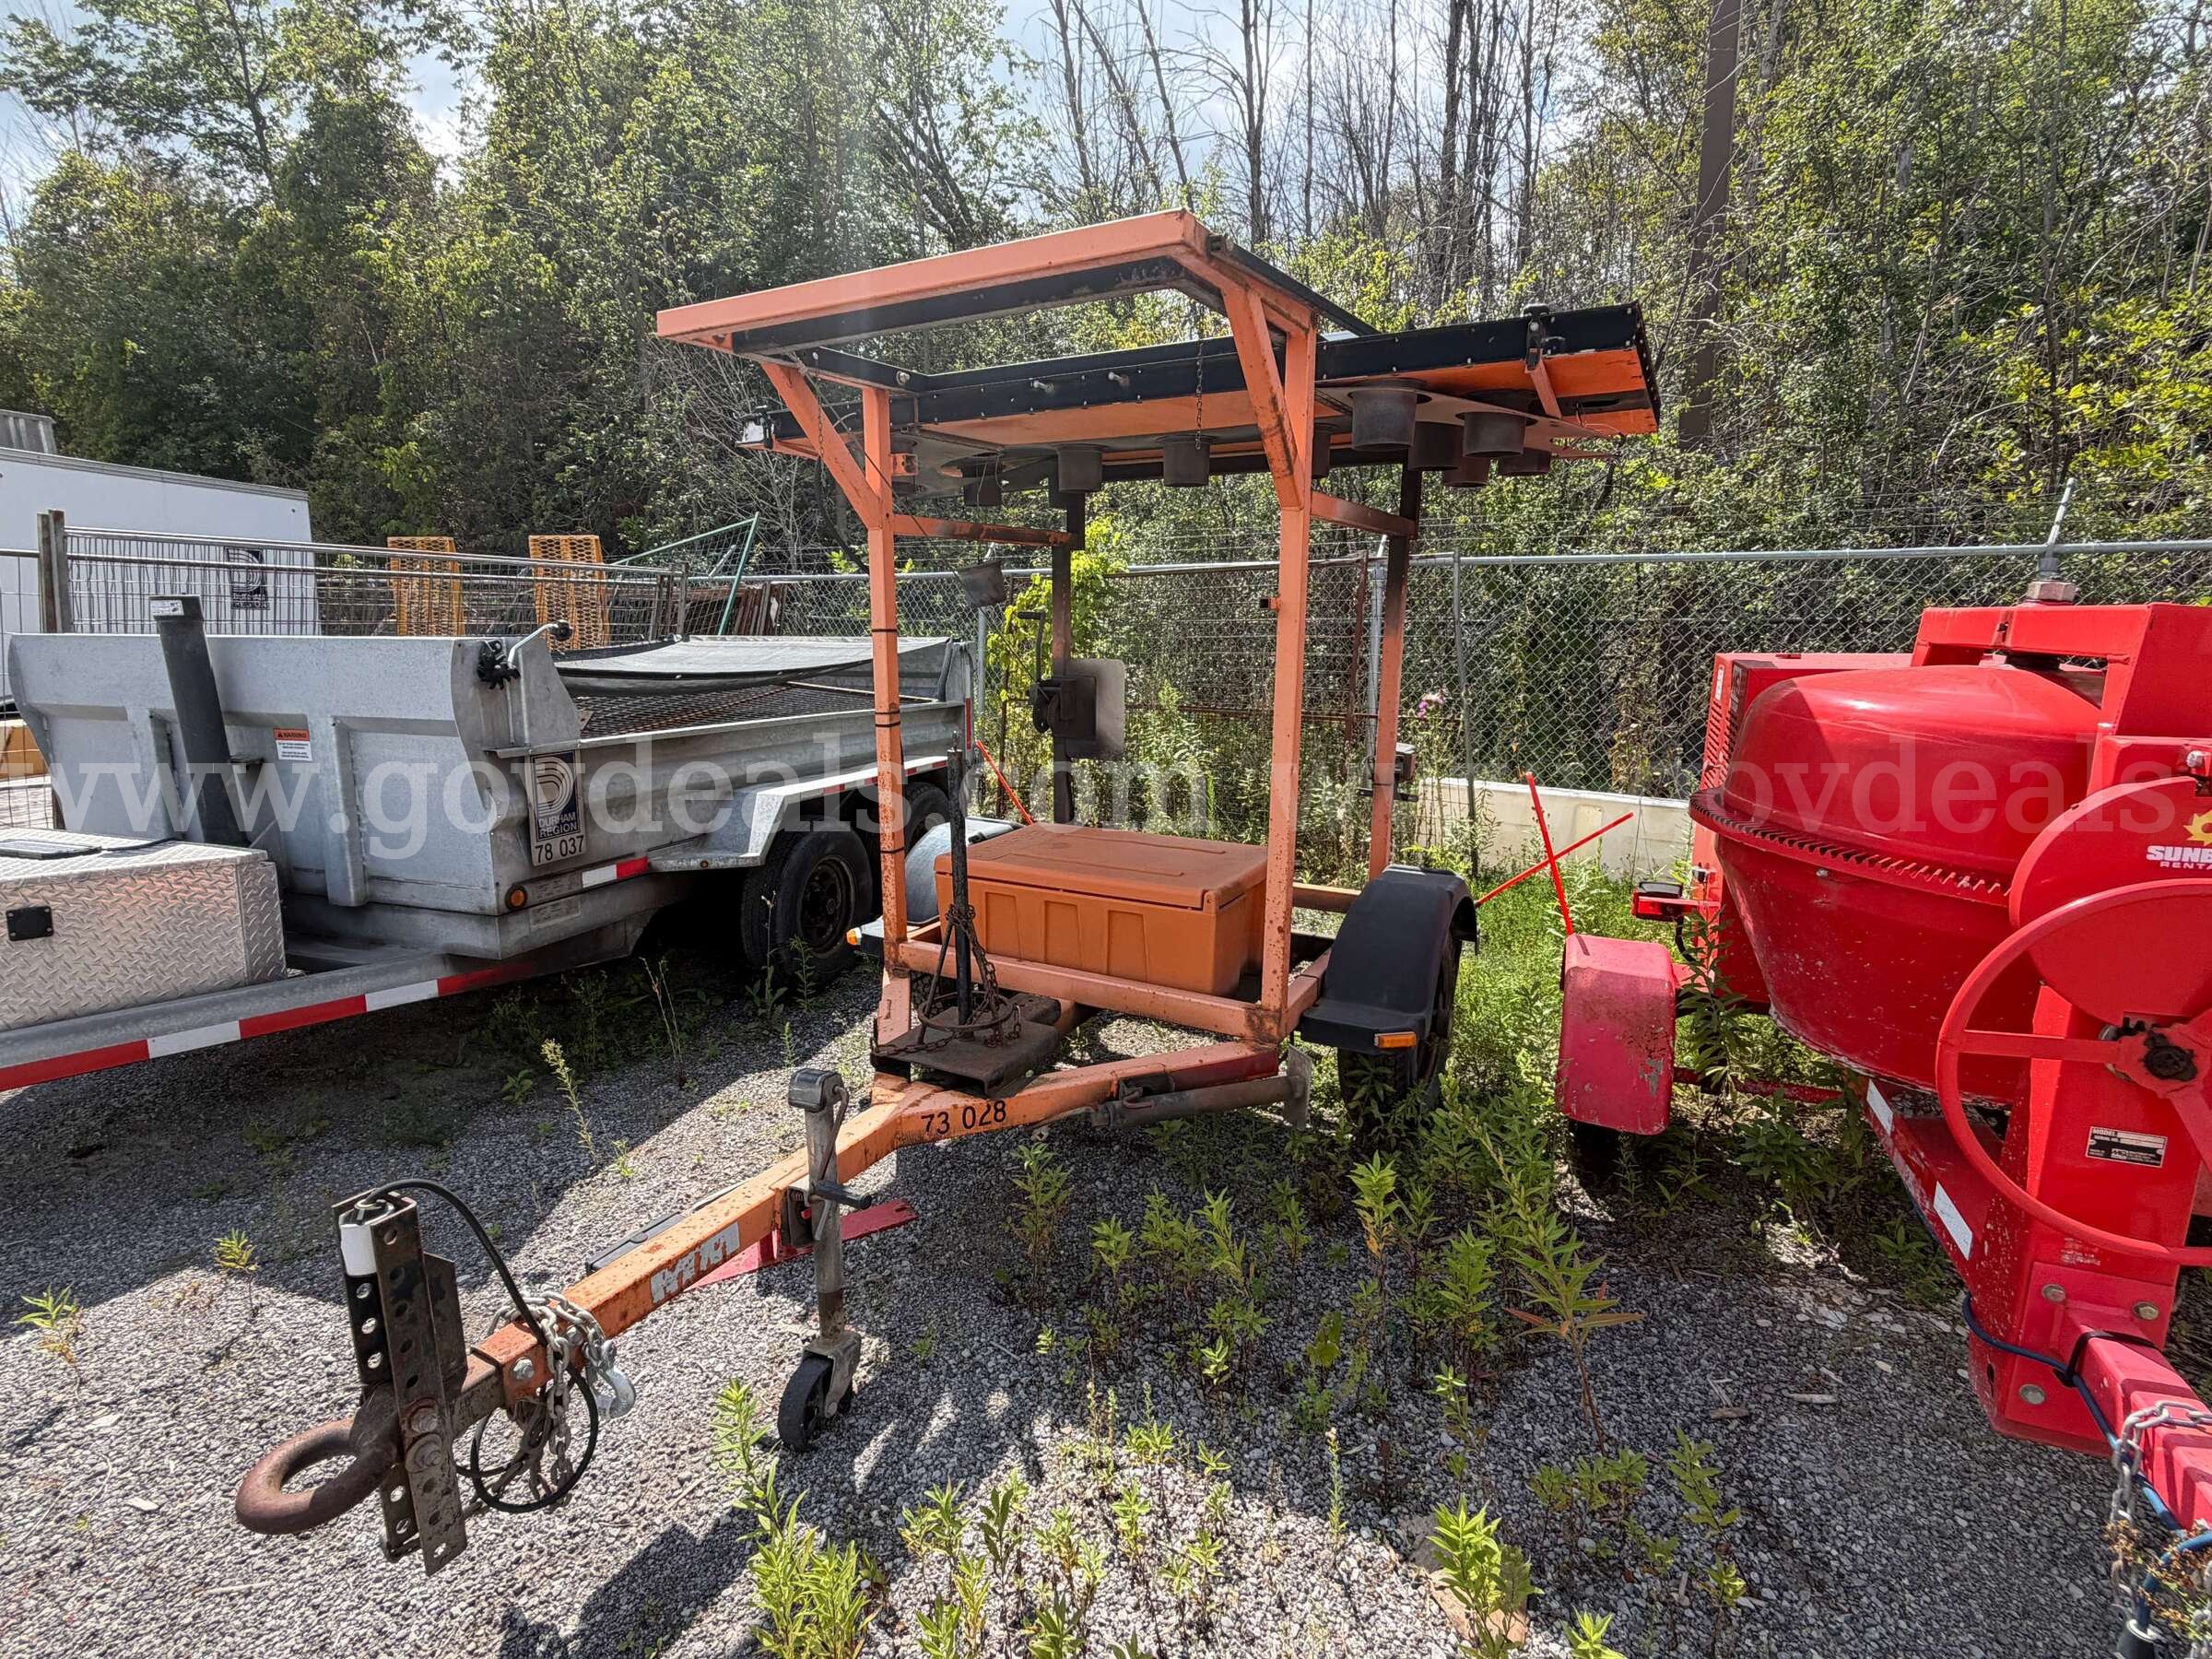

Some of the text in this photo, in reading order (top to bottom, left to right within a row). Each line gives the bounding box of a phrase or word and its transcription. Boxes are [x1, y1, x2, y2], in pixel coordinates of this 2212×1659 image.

[538, 812, 576, 828] DURHAM
[539, 822, 577, 838] REGION
[535, 835, 584, 863] 78 037
[922, 1100, 1006, 1135] 73 028
